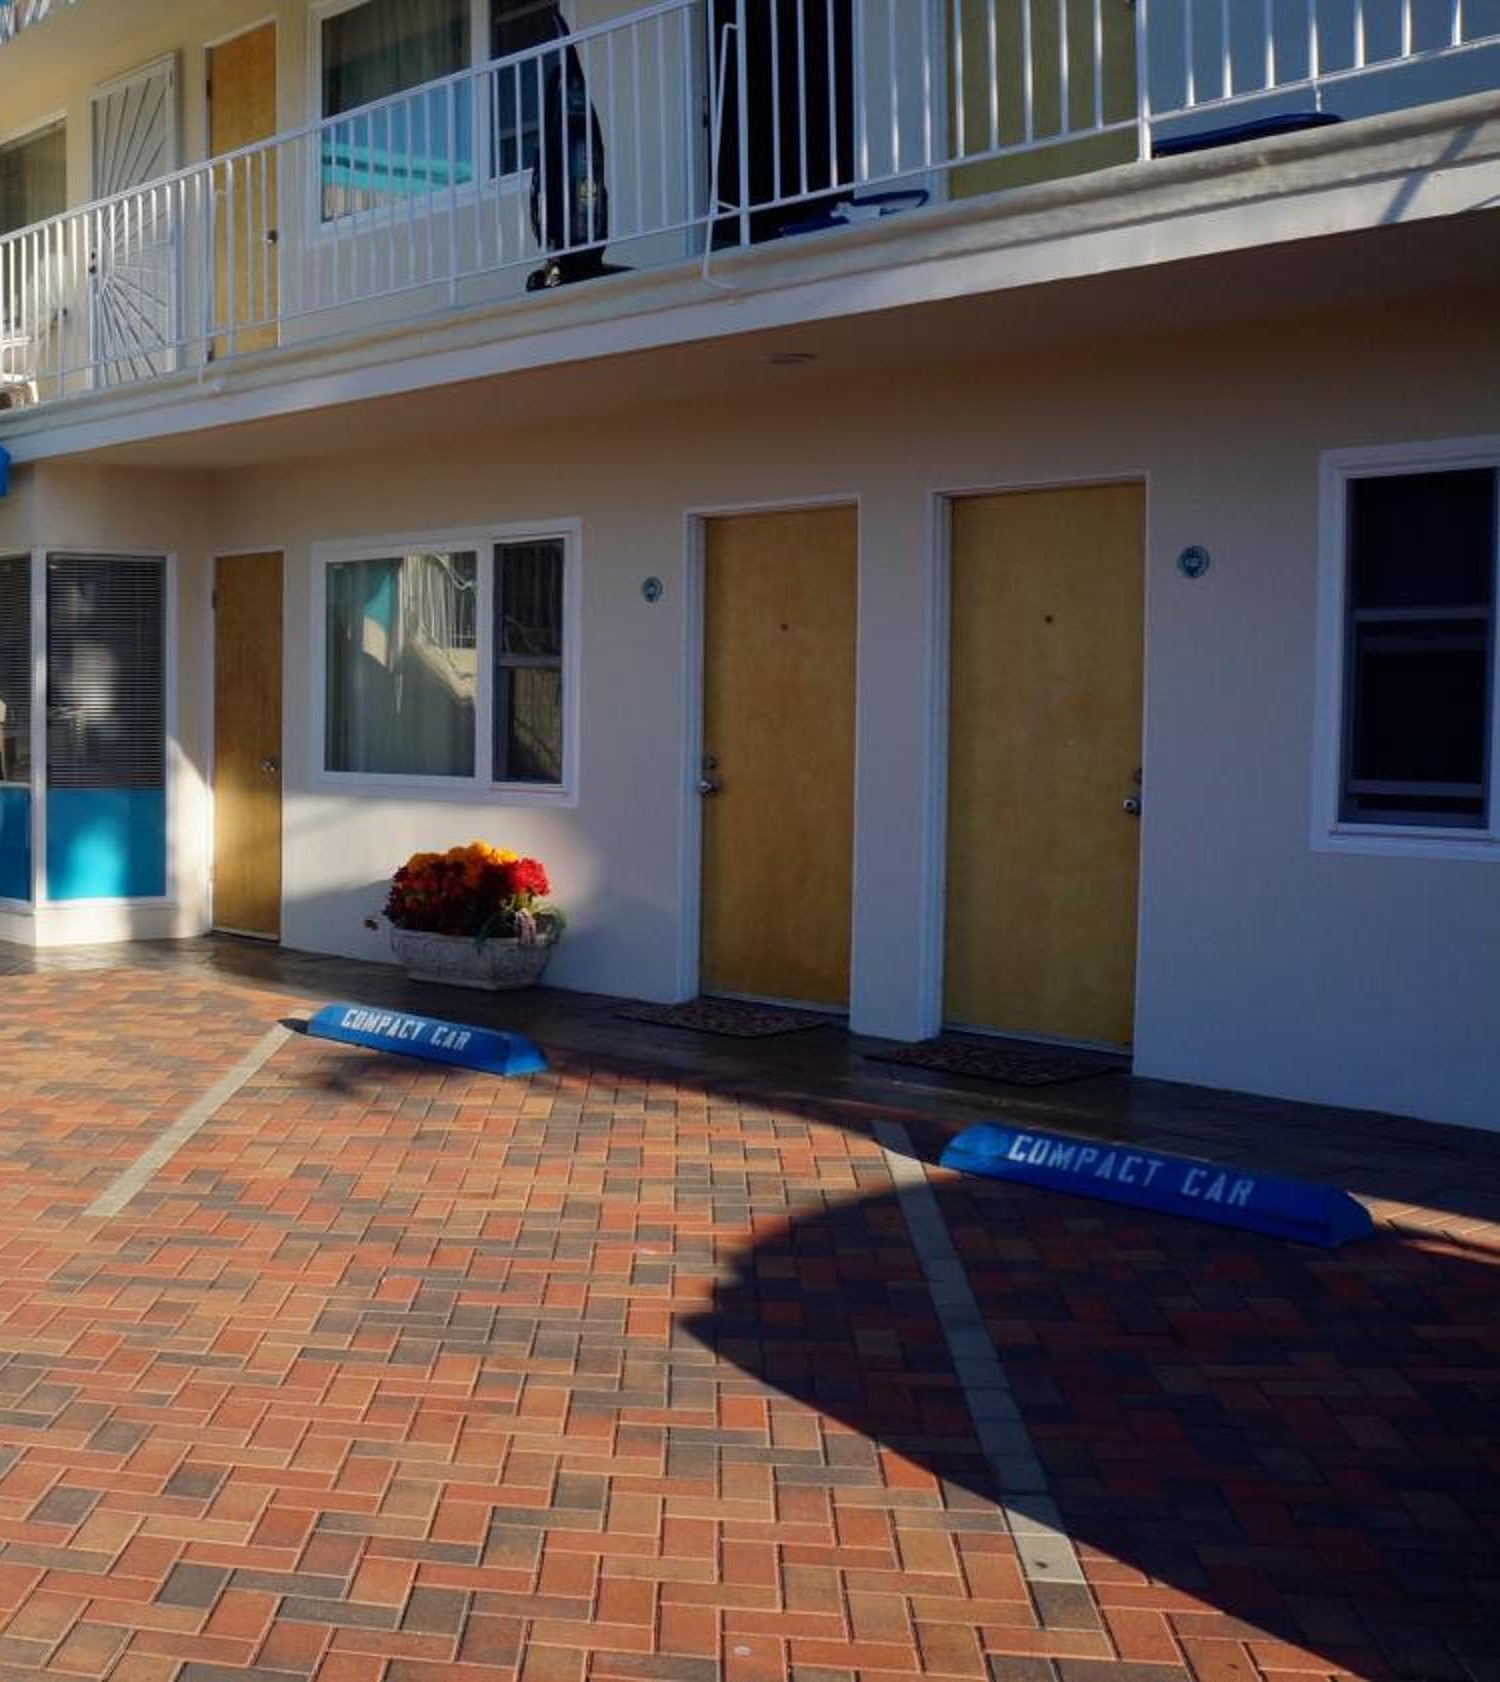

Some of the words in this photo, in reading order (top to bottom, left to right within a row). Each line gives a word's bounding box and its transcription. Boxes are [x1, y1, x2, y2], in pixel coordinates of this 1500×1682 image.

[341, 1009, 426, 1041] COMPACT
[431, 1026, 473, 1051] CAR
[1007, 1134, 1164, 1187] COMPACT
[1181, 1168, 1255, 1208] CAR
